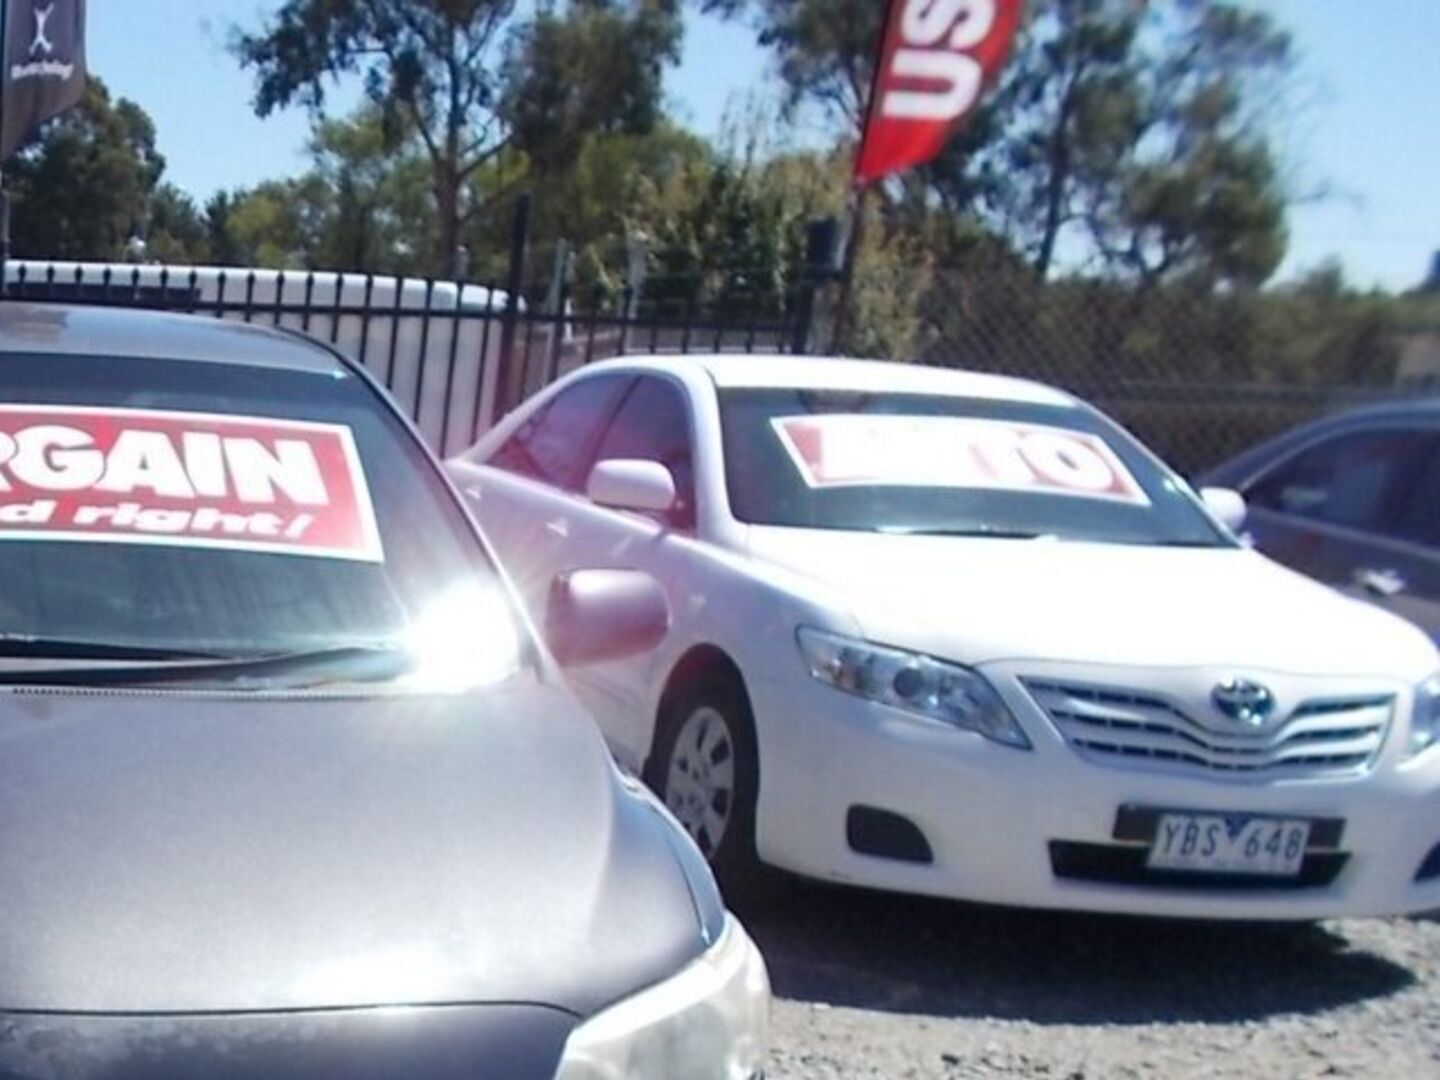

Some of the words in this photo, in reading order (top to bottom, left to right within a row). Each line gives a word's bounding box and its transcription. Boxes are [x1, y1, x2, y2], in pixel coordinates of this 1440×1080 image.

[72, 505, 321, 540] right!
[1164, 817, 1221, 856] YBS
[1244, 825, 1302, 860] 648
